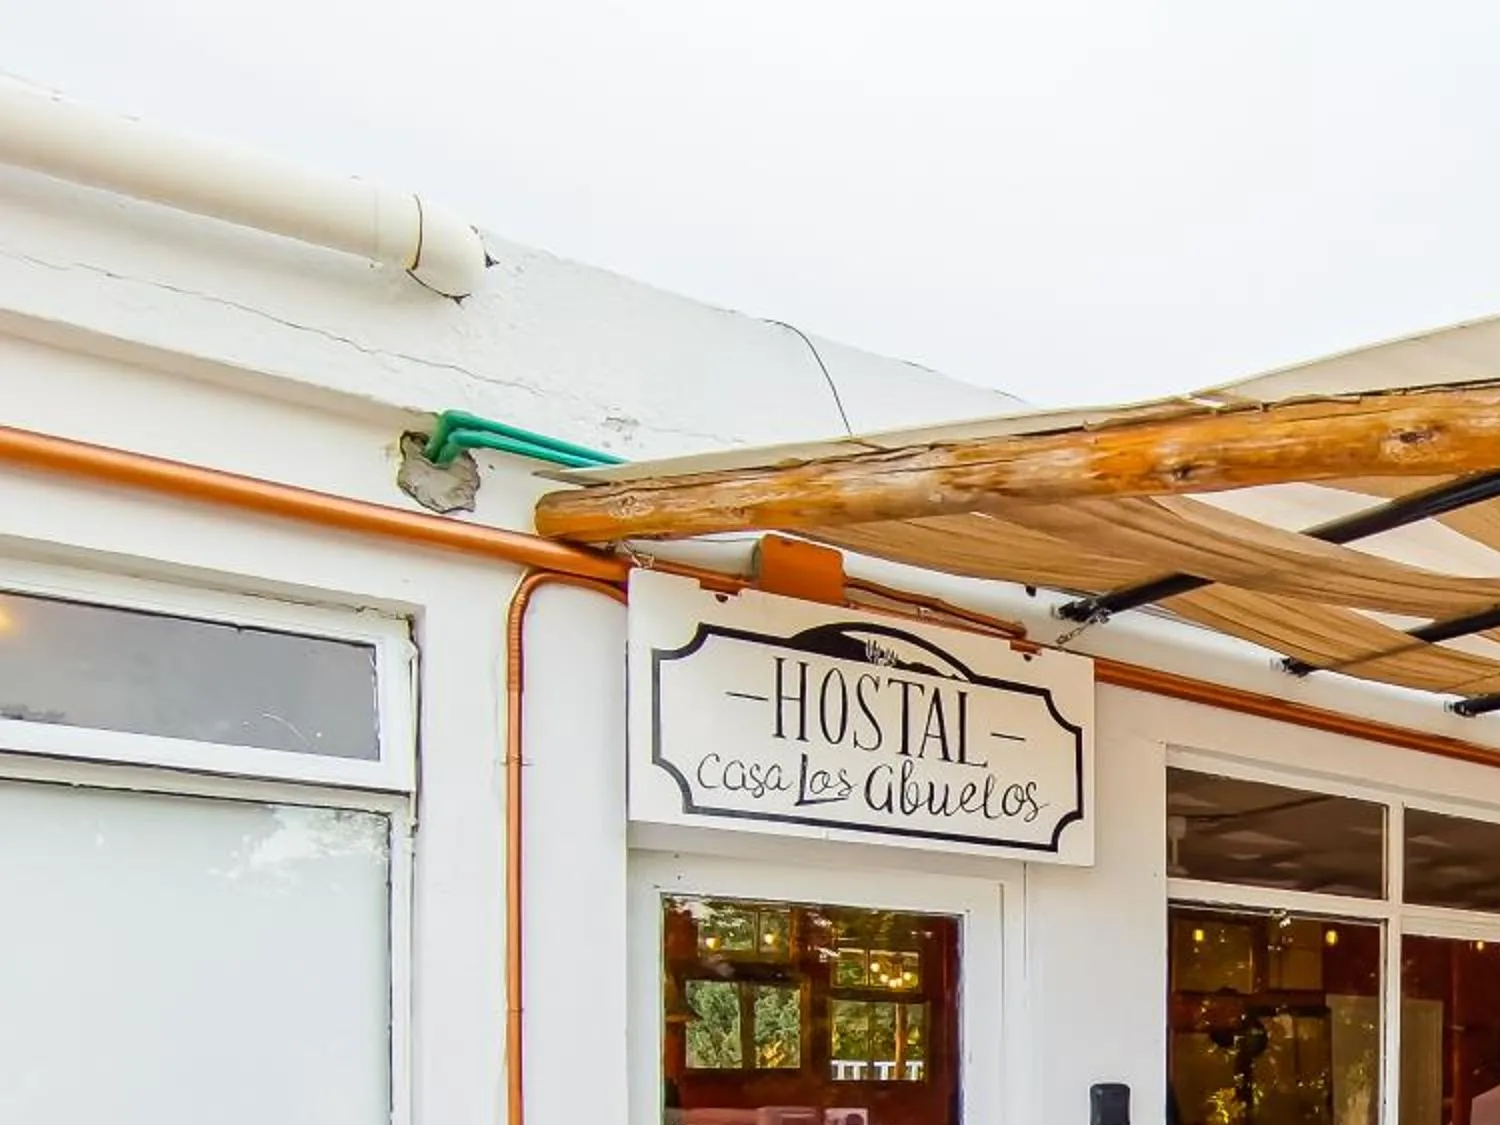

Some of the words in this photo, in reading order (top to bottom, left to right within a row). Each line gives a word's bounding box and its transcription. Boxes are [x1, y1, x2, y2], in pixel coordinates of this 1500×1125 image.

[773, 656, 988, 768] HOSTAL
[697, 753, 793, 798] Casa
[795, 753, 858, 806] Los
